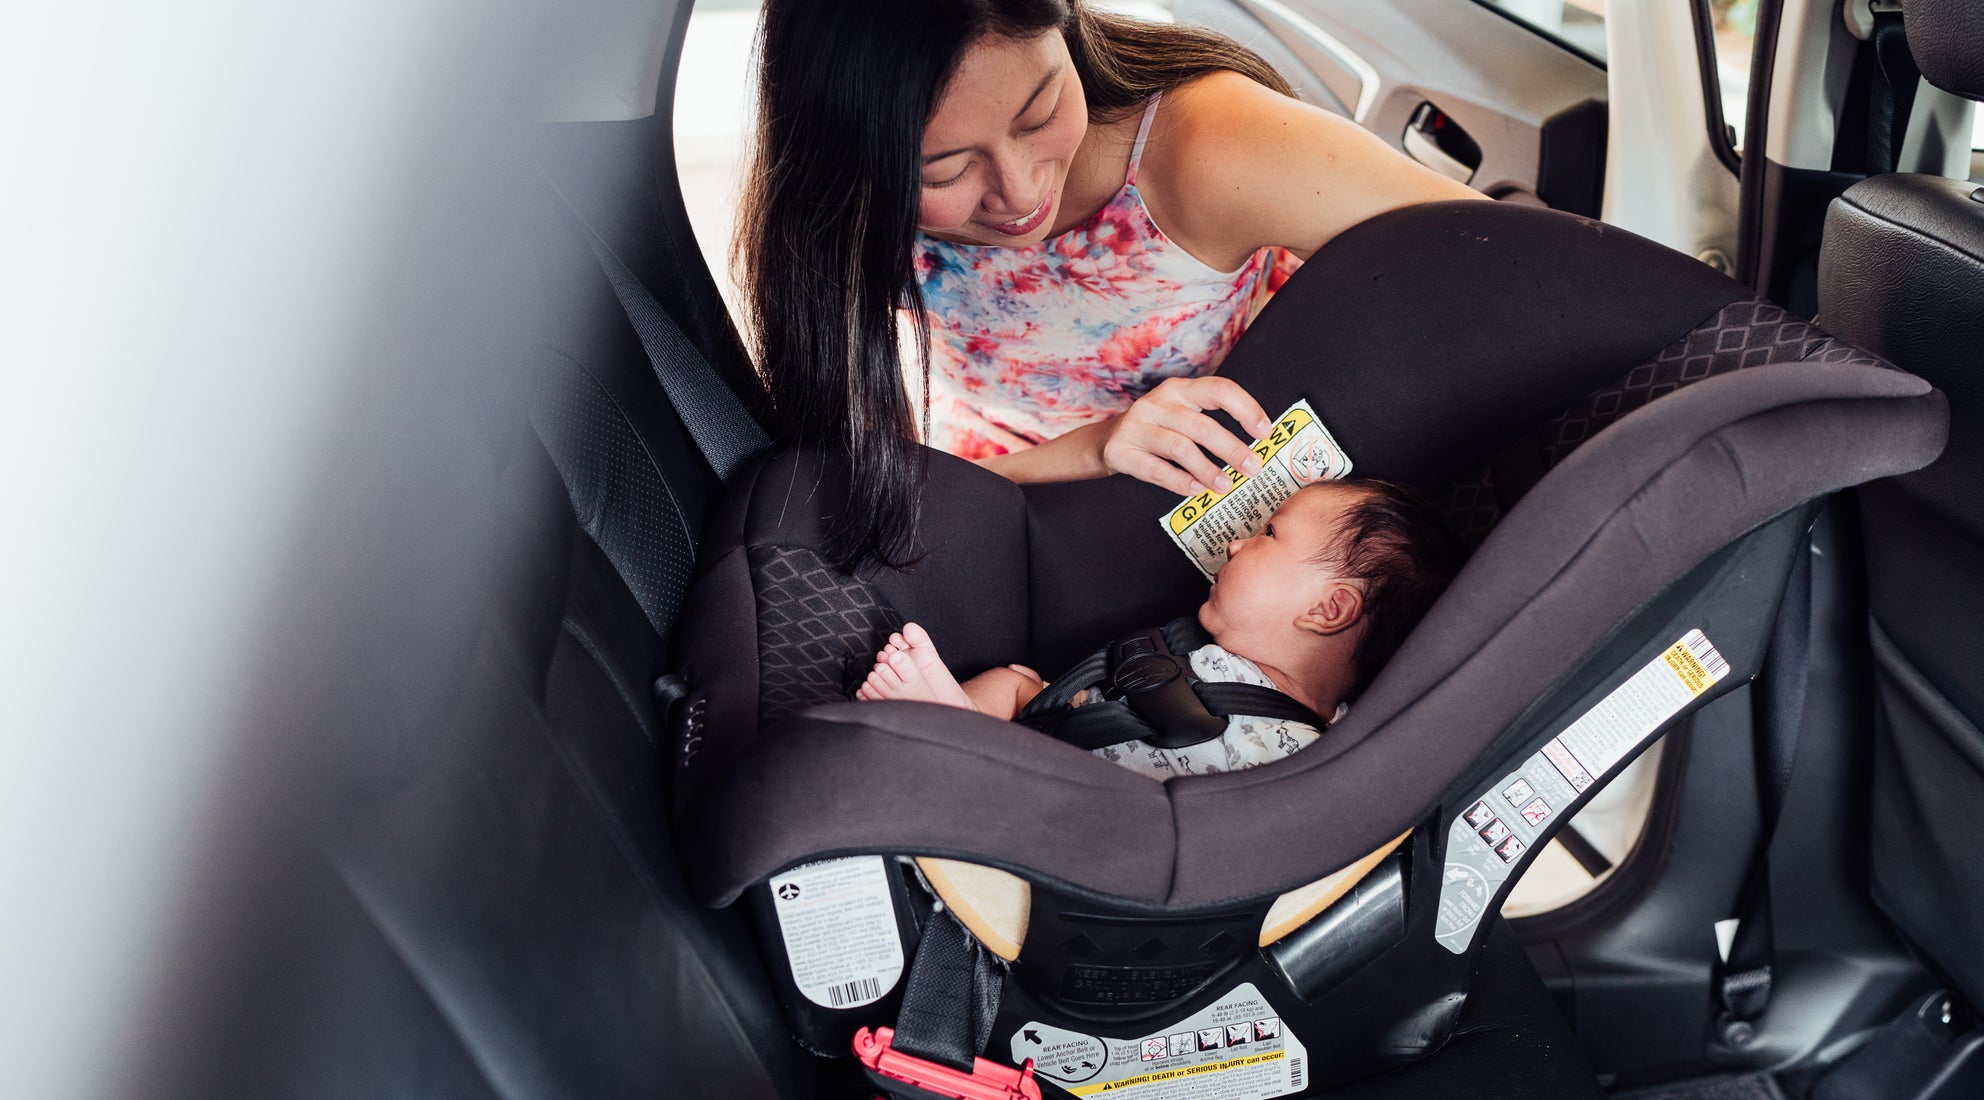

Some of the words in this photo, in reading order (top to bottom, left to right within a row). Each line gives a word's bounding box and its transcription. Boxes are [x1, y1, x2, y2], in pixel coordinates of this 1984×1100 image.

[1256, 474, 1268, 489] child
[1265, 488, 1277, 502] seat
[1262, 470, 1286, 502] rear-facing
[1267, 465, 1277, 476] DO
[1275, 475, 1287, 489] NOT
[1238, 489, 1255, 510] DEATH
[1251, 508, 1262, 520] OR
[1249, 492, 1262, 506] bag.
[1250, 479, 1262, 493] front
[1259, 492, 1272, 506] seat
[1220, 503, 1237, 523] occur.
[1227, 498, 1246, 521] INJURY
[1242, 521, 1253, 533] can
[1232, 493, 1255, 521] SERIOUS
[1201, 516, 1218, 534] place
[1215, 533, 1224, 544] for
[1213, 518, 1224, 530] the
[1214, 508, 1225, 521] The
[1222, 520, 1237, 536] back
[1199, 537, 1217, 558] under.
[1215, 546, 1224, 555] 12
[1664, 654, 1680, 671] INJURY
[1669, 649, 1684, 665] DEATH
[1685, 668, 1704, 689] SERIOUS
[1680, 649, 1706, 678] WARNING!
[1216, 1003, 1232, 1011] REAR
[1233, 999, 1258, 1008] FACING
[1036, 1052, 1055, 1062] Lower
[1055, 1047, 1075, 1058] Anchor
[1076, 1045, 1088, 1053] Belt
[1042, 1044, 1061, 1053] REAR
[1061, 1039, 1088, 1049] FACING
[1036, 1058, 1057, 1069] Vehicle
[1057, 1056, 1069, 1064] Belt
[1070, 1053, 1084, 1062] Goes
[1085, 1050, 1099, 1059] Here
[1113, 1075, 1150, 1088] WARNING!
[1151, 1071, 1175, 1080] DEATH
[1186, 1063, 1217, 1074] SERIOUS
[1219, 1058, 1244, 1069] INJURY
